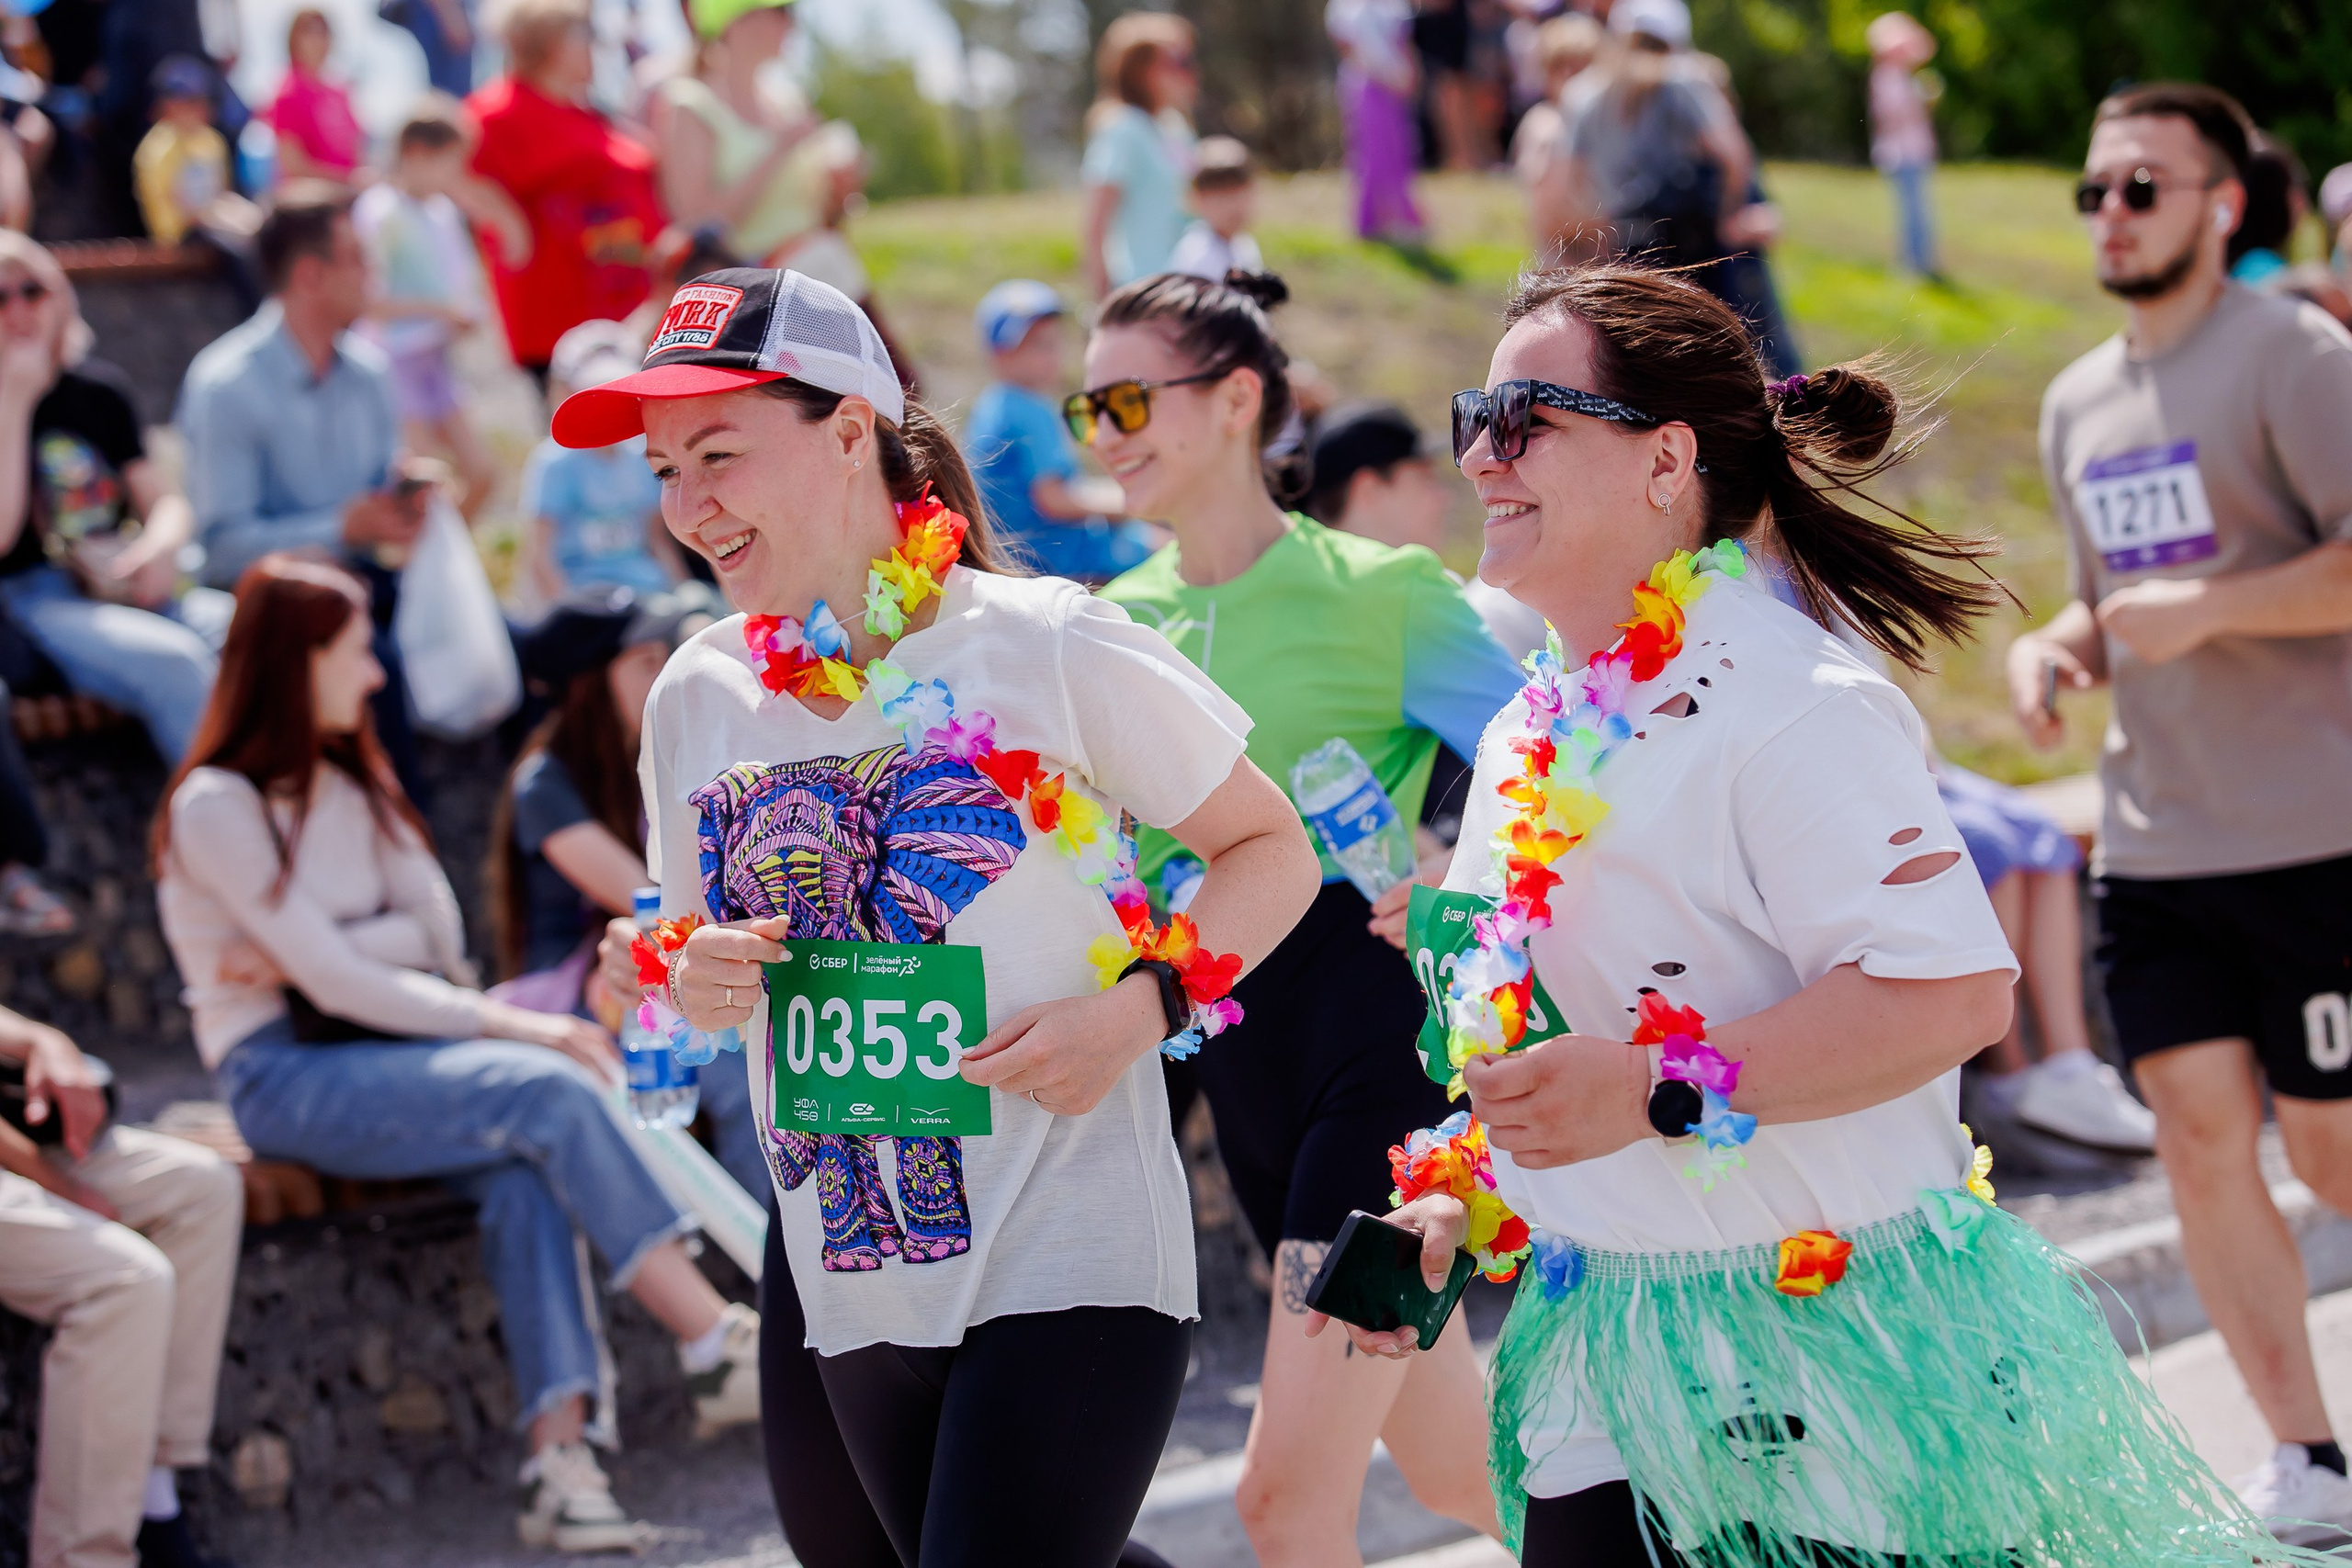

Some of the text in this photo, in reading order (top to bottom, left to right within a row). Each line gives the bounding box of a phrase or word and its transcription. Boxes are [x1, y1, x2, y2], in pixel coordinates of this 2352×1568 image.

[692, 289, 736, 302] FASHION
[683, 332, 709, 344] 1788
[2094, 479, 2188, 536] 1271
[1450, 909, 1466, 922] СБЕР
[821, 957, 848, 968] СБЕР
[865, 955, 901, 965] зелёный
[861, 964, 899, 975] марафон
[786, 995, 963, 1080] 0353
